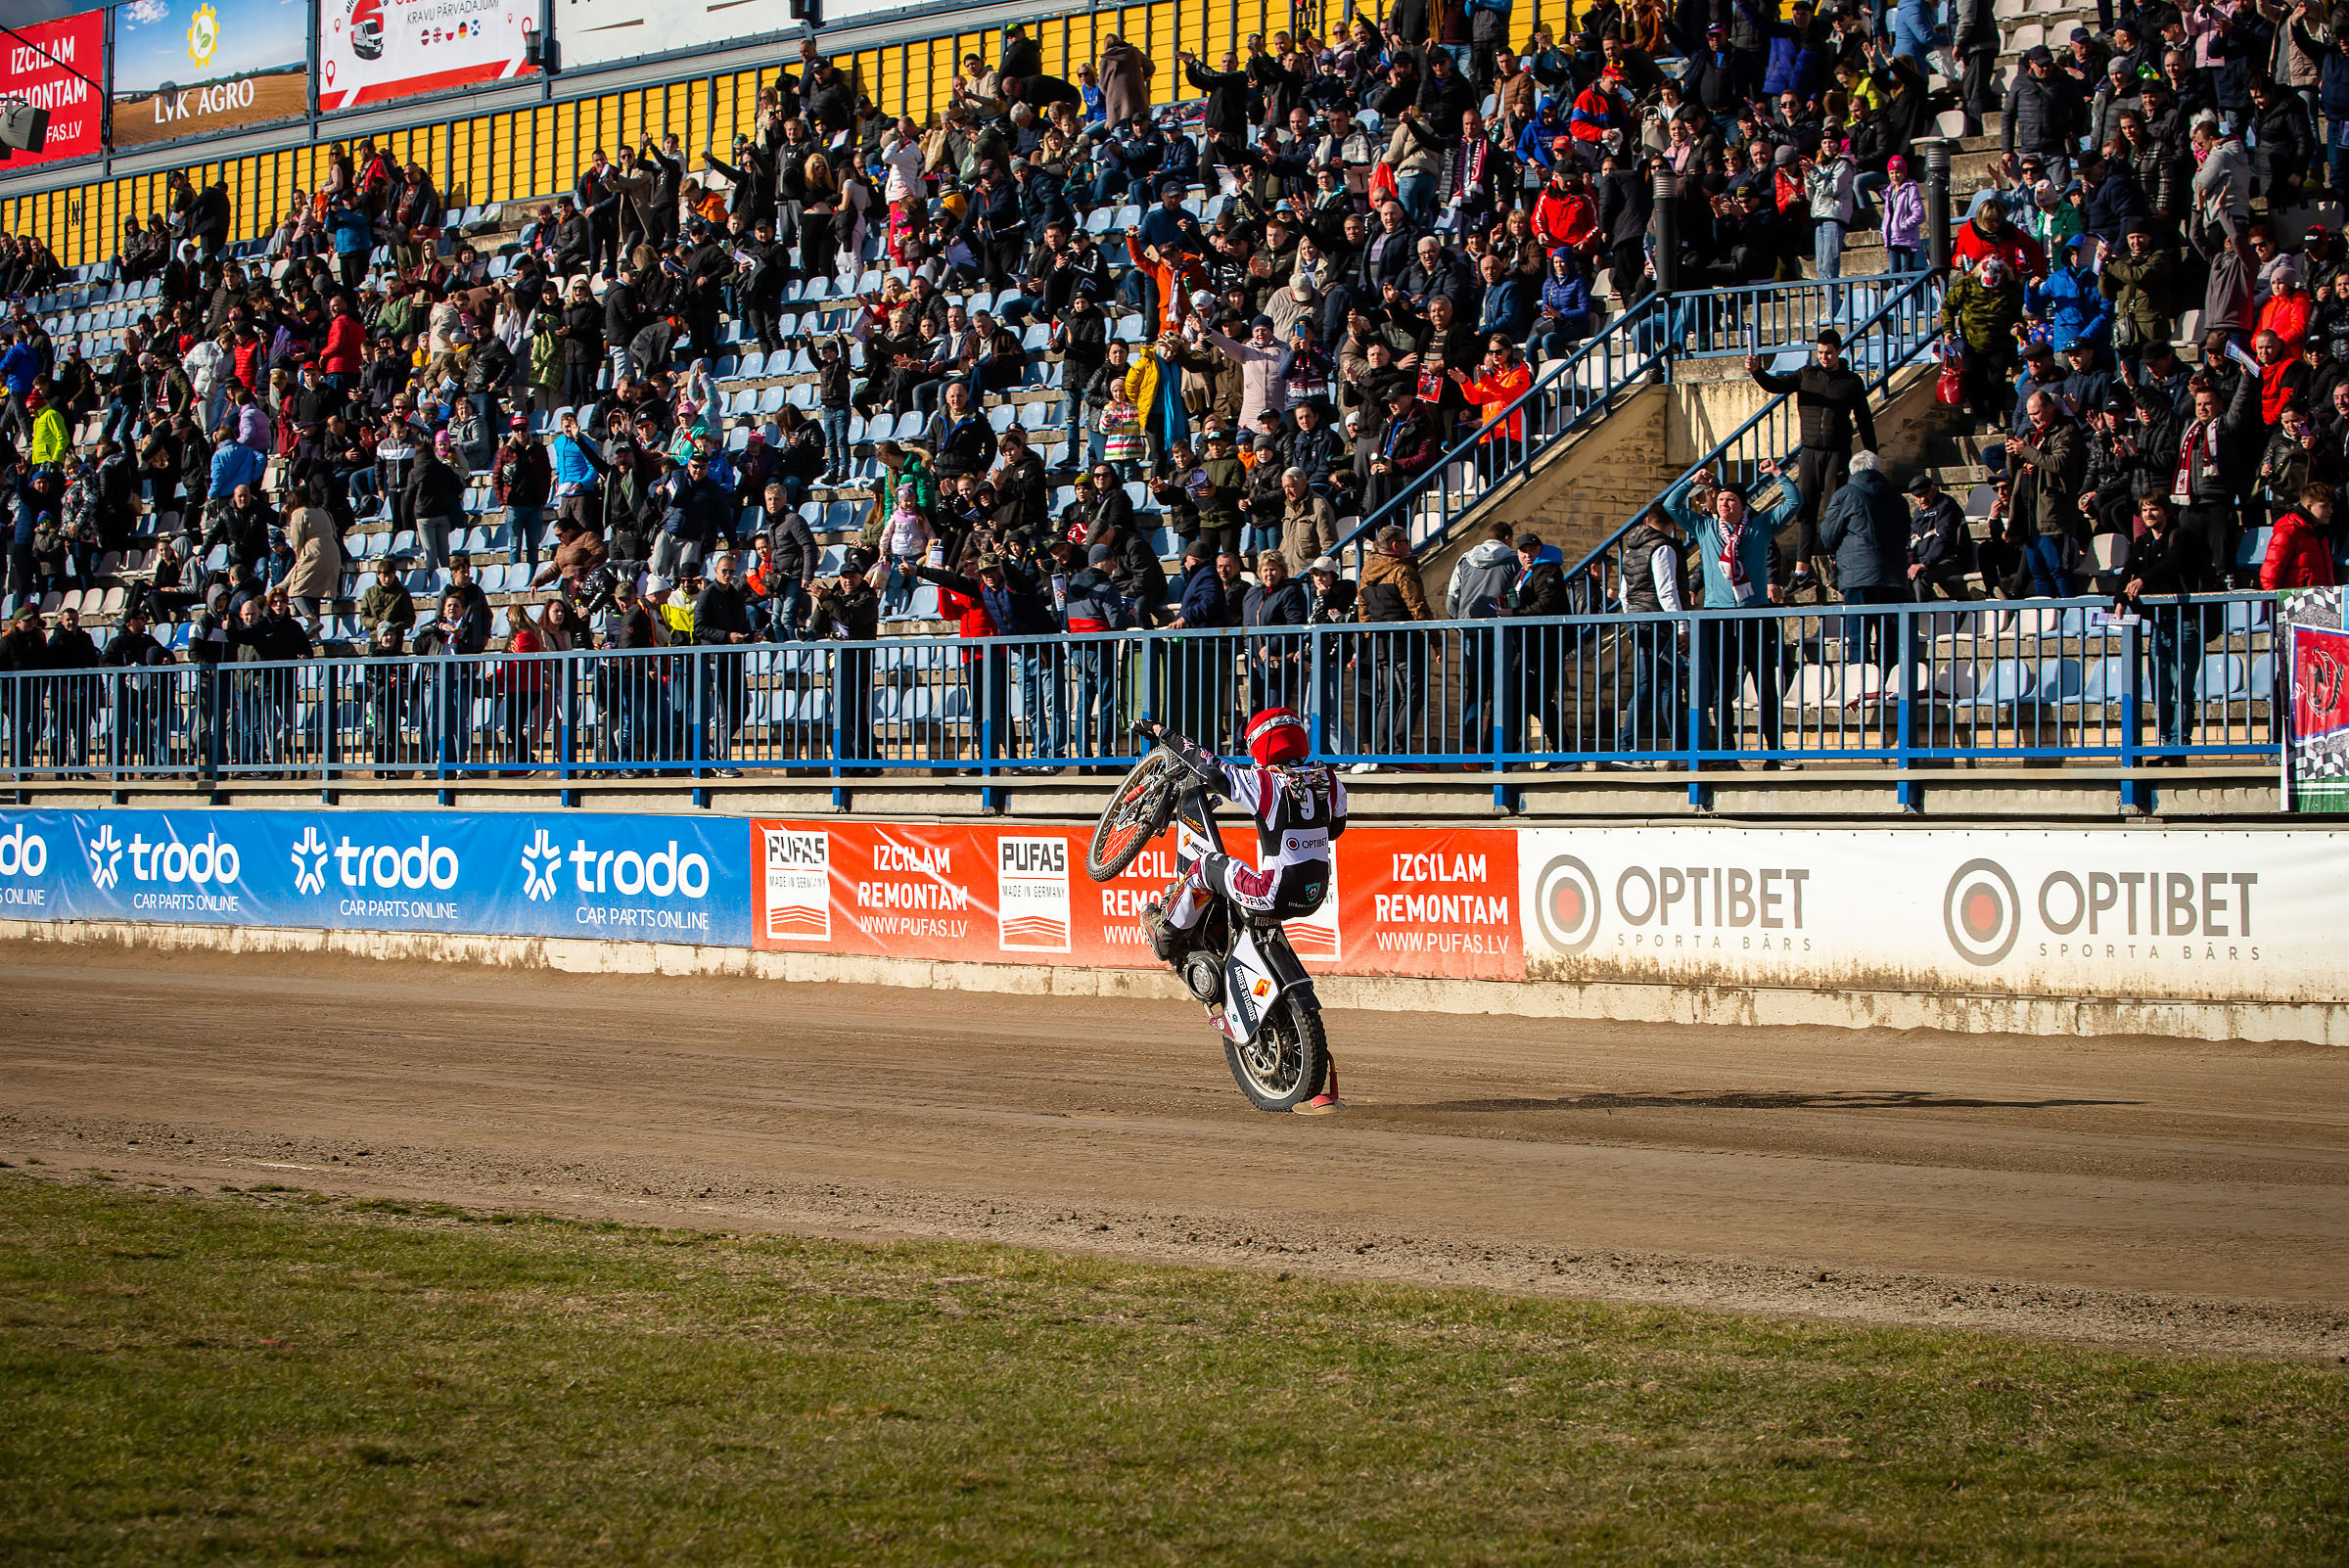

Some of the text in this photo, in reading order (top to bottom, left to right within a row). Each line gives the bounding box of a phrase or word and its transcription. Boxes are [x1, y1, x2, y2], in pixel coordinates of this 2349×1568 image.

[406, 9, 436, 24] KRAVU
[11, 35, 75, 75] IZCILAM
[155, 78, 255, 124] LVK AGRO
[46, 119, 83, 144] FAS.LV
[1300, 787, 1314, 820] 9
[768, 837, 824, 863] PUFAS
[1302, 837, 1328, 849] OPTIBET
[127, 832, 241, 885] trodo
[334, 835, 459, 891] trodo
[568, 839, 710, 899] trodo
[873, 845, 951, 873] IZCILAM
[1002, 843, 1065, 872] PUFAS
[1120, 852, 1177, 878] ZCIL
[1393, 853, 1487, 882] IZCILAM
[5, 888, 45, 905] ONLINE
[134, 893, 239, 912] CAR PARTS ONLINE
[857, 882, 968, 911] REMONTAM
[1002, 885, 1066, 899] MADE IN GERMANY
[1102, 889, 1163, 916] REMO
[1616, 866, 1810, 929] OPTIBET
[2038, 871, 2258, 937] OPTIBET
[341, 899, 458, 919] CAR PARTS ONLINE
[576, 906, 710, 930] CAR PARTS ONLINE
[1374, 894, 1509, 925] REMONTAM
[859, 915, 968, 939] WWW.PUFAS.LV
[1375, 932, 1509, 954] WWW.PUFAS.LV
[1617, 934, 1811, 951] SPORTA BĀRS
[2040, 943, 2260, 961] SPORTA BĀRS
[1233, 965, 1258, 1022] AMBER STUDIOS
